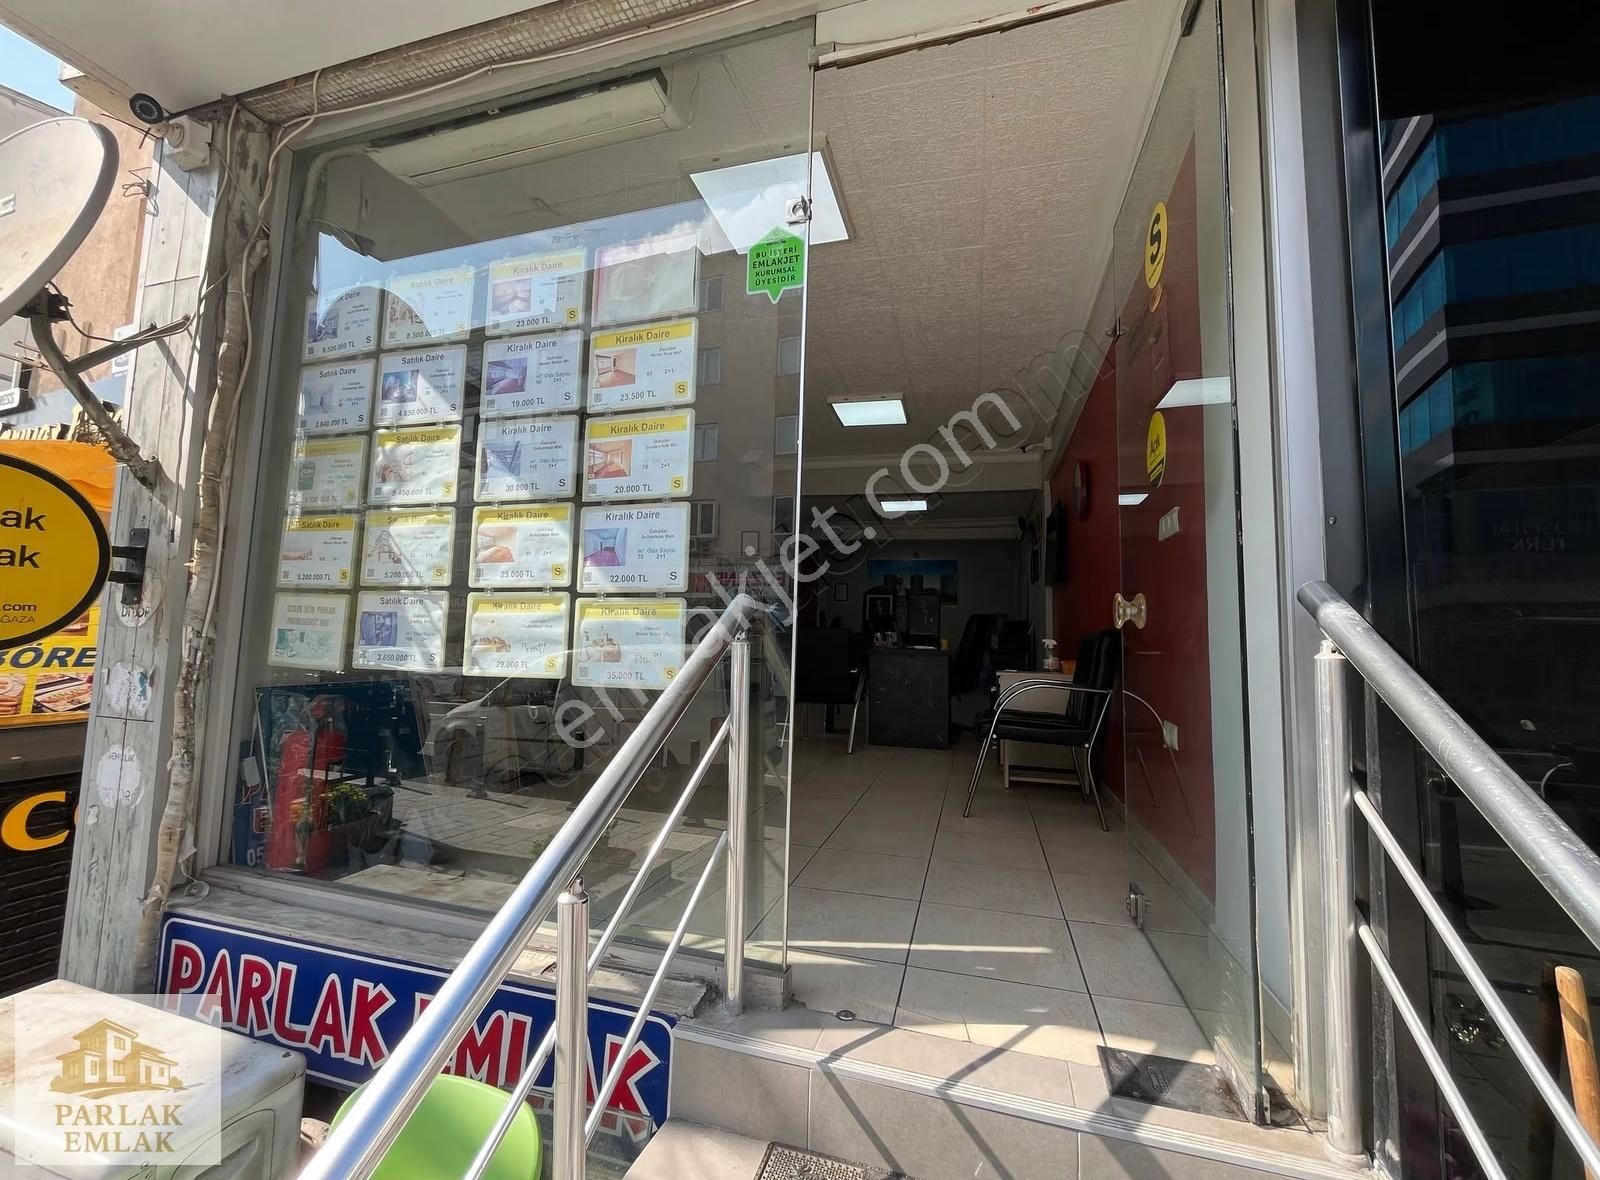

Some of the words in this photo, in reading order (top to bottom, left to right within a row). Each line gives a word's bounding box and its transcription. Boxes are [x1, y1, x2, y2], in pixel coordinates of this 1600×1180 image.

[756, 251, 767, 259] BU
[769, 244, 797, 257] İŞYERİ
[752, 255, 801, 269] EMLAKJET
[755, 266, 797, 278] KURUMSAL
[755, 274, 796, 287] ÜYESİDİR
[568, 310, 576, 319] S
[516, 318, 540, 328] 23.000
[541, 316, 551, 324] TL
[616, 333, 644, 344] Kiralık
[646, 330, 670, 340] Daire
[507, 342, 533, 352] Kiralık
[535, 340, 557, 349] Daire
[401, 356, 424, 365] Satılık
[426, 353, 445, 362] Daire
[339, 367, 357, 376] Daire
[678, 384, 686, 394] S
[564, 391, 571, 400] S
[620, 391, 645, 401] 23.500
[647, 390, 656, 398] TL
[512, 398, 535, 407] 19.000
[536, 397, 545, 405] TL
[450, 403, 457, 411] S
[358, 414, 364, 422] S
[502, 426, 527, 435] Kiralık
[529, 423, 552, 433] Daire
[610, 424, 639, 434] Kiralık
[641, 422, 665, 432] Daire
[505, 483, 529, 492] 30.000
[530, 482, 540, 490] TL
[558, 478, 566, 487] S
[673, 479, 681, 488] S
[614, 484, 640, 493] 20.000
[642, 483, 653, 492] TL
[497, 511, 524, 520] Kiralık
[526, 510, 549, 519] Daire
[605, 511, 634, 521] Kiralık
[636, 510, 661, 520] Daire
[301, 520, 321, 529] Satılık
[322, 520, 340, 528] Daire
[342, 571, 347, 579] S
[436, 568, 442, 577] S
[500, 570, 524, 578] 25.000
[525, 569, 535, 578] TL
[554, 567, 561, 576] S
[670, 571, 678, 580] S
[324, 573, 331, 581] TL
[610, 574, 636, 583] 22.000
[637, 574, 648, 583] TL
[380, 596, 402, 605] Satılık
[403, 596, 424, 605] Daire
[520, 601, 541, 610] Daire
[602, 607, 630, 616] Kiralık
[632, 606, 657, 616] Daire
[430, 653, 436, 661] S
[496, 660, 519, 669] 29.000
[521, 660, 528, 668] TL
[548, 659, 555, 668] S
[607, 671, 633, 680] 35.000
[635, 671, 646, 680] TL
[666, 670, 674, 679] S
[164, 939, 396, 1070] PARLAK
[413, 992, 660, 1143] MLK
